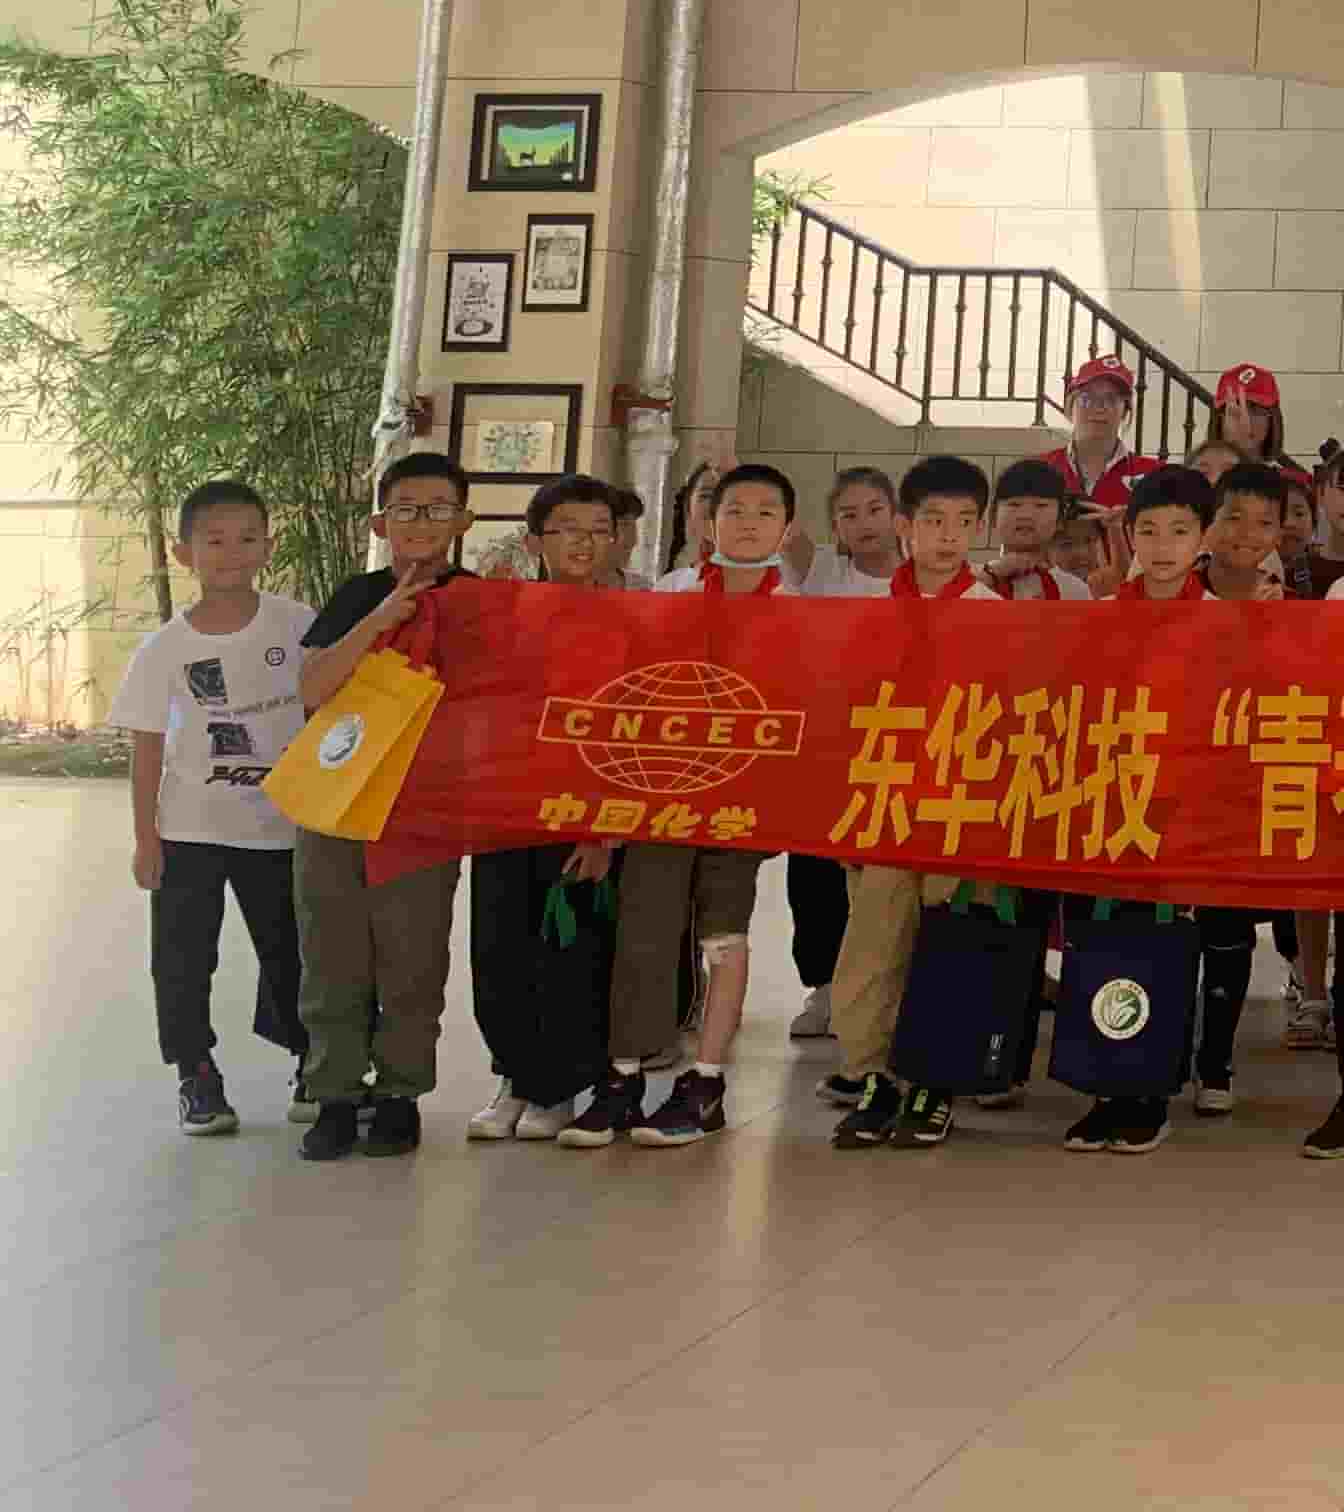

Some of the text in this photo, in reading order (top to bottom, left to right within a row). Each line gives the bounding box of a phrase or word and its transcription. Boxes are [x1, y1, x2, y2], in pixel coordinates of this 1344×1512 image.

[563, 707, 784, 747] CNCEC
[829, 679, 1168, 863] 东华科技
[537, 791, 758, 841] 中国化学
